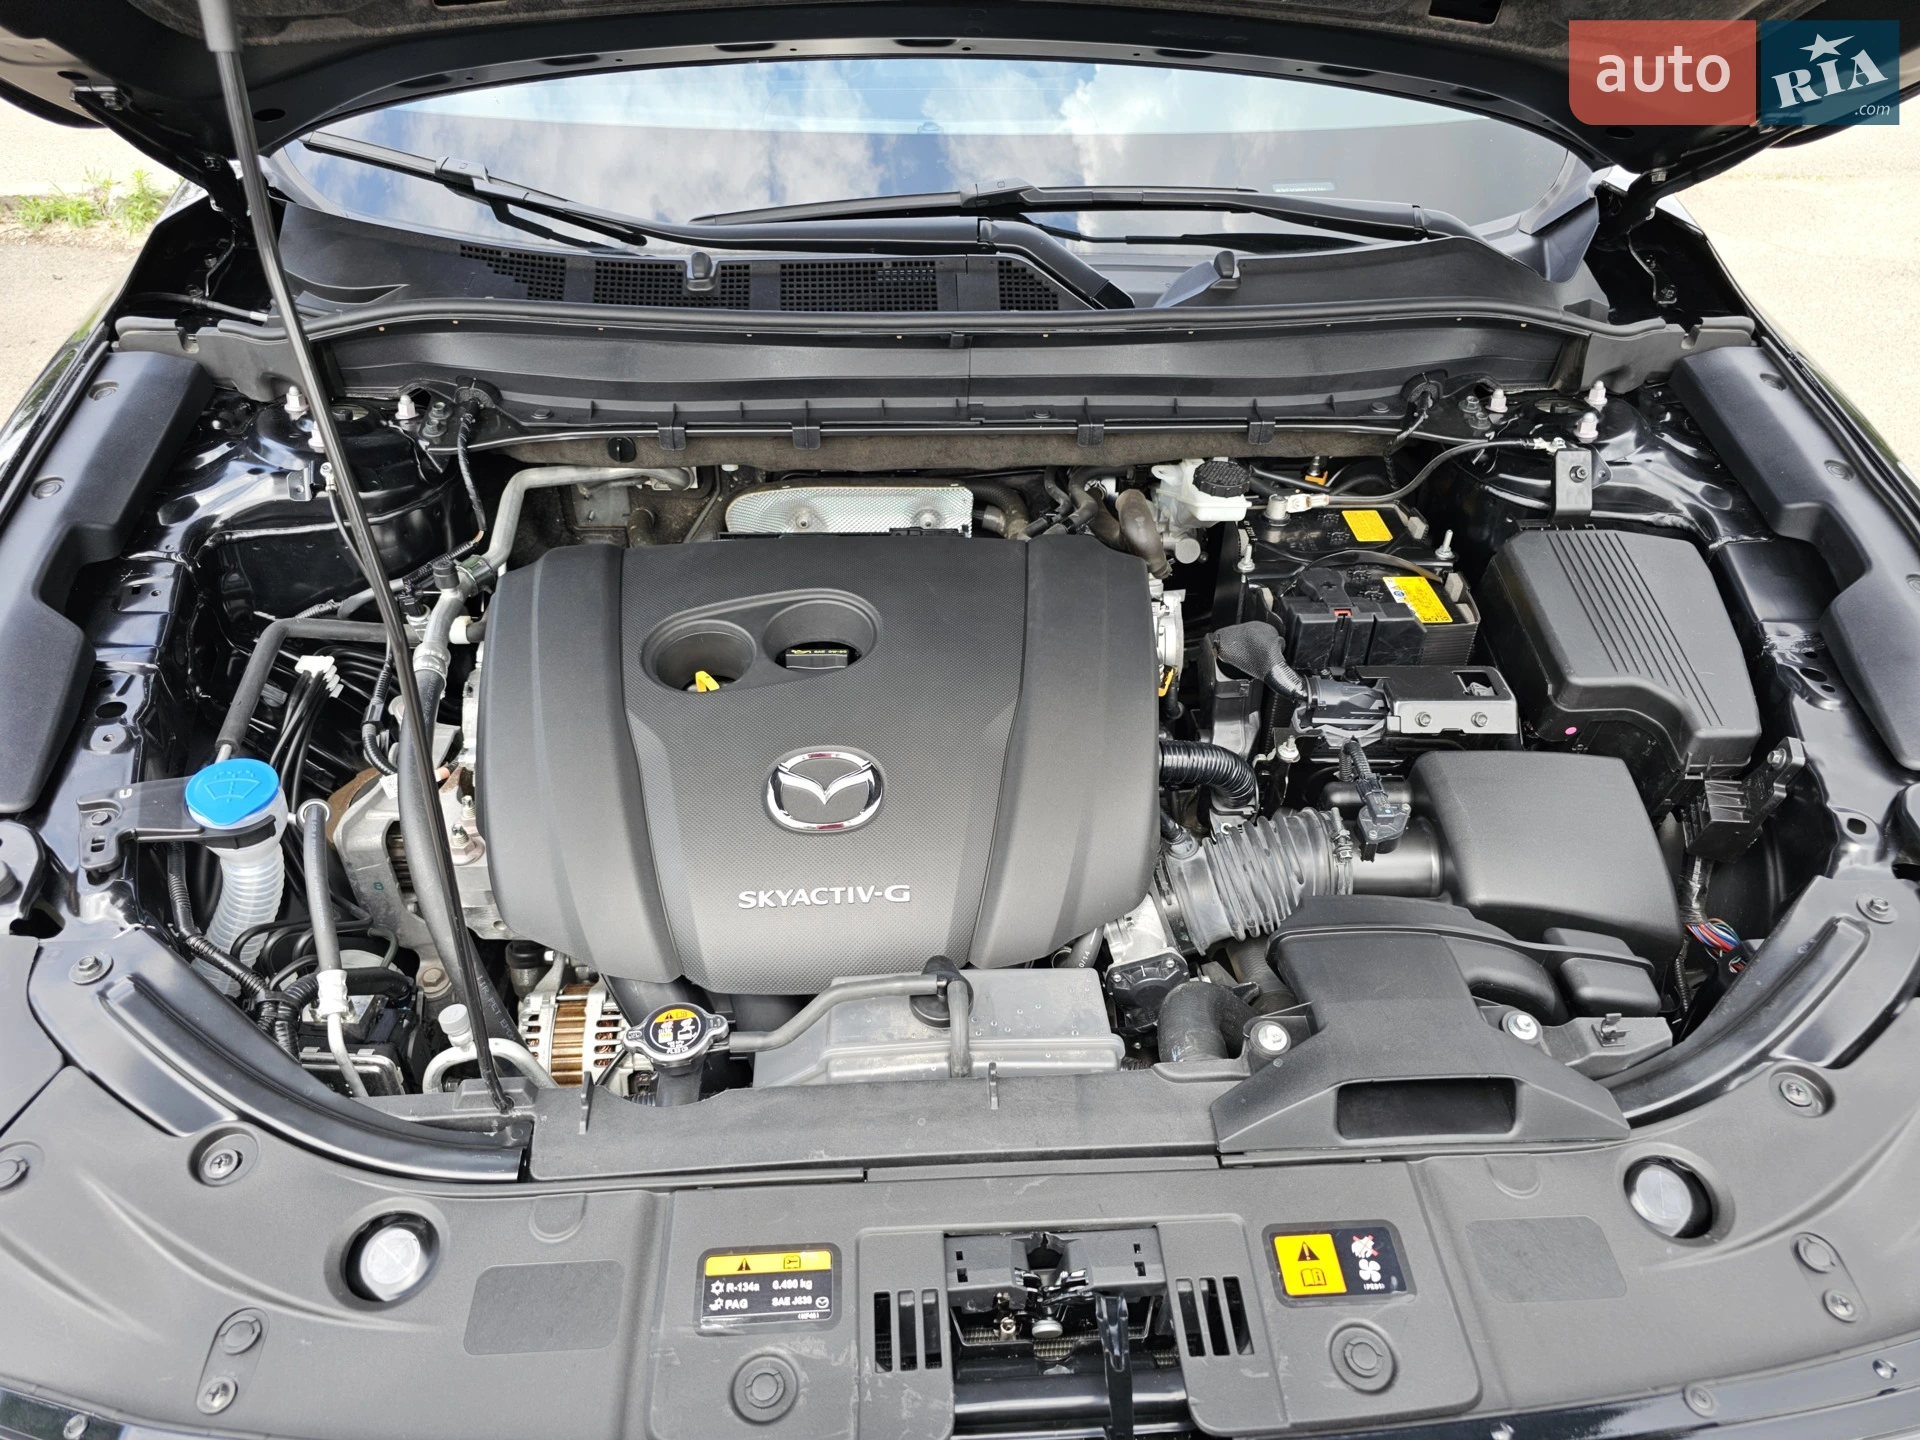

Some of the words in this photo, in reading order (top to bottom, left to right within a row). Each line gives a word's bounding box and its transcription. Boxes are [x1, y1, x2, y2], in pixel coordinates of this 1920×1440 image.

[738, 884, 911, 909] SKYACTIV-G
[726, 1281, 760, 1293] R-134a
[800, 1278, 813, 1290] kg
[725, 1298, 748, 1309] PAG
[772, 1296, 791, 1307] SAE
